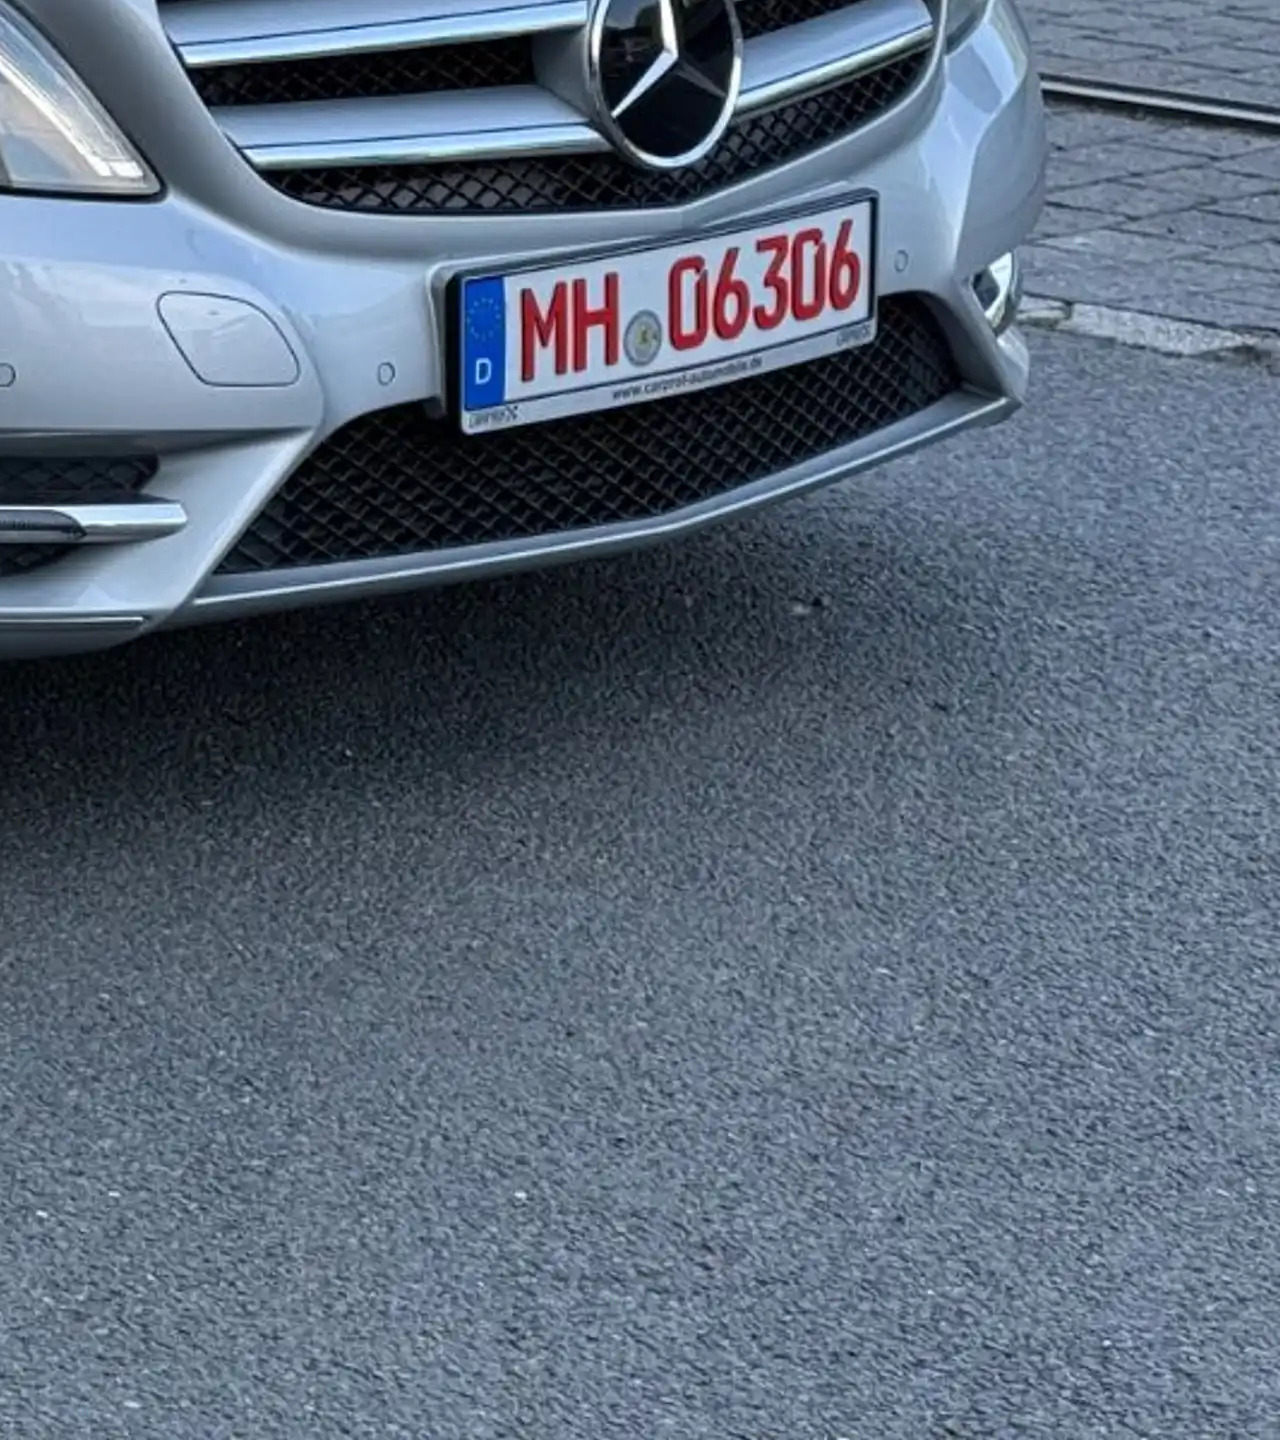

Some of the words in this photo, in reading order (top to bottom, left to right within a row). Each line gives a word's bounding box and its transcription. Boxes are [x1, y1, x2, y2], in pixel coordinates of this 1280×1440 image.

[520, 271, 620, 383] MH
[668, 218, 861, 352] 06306
[474, 357, 492, 385] D
